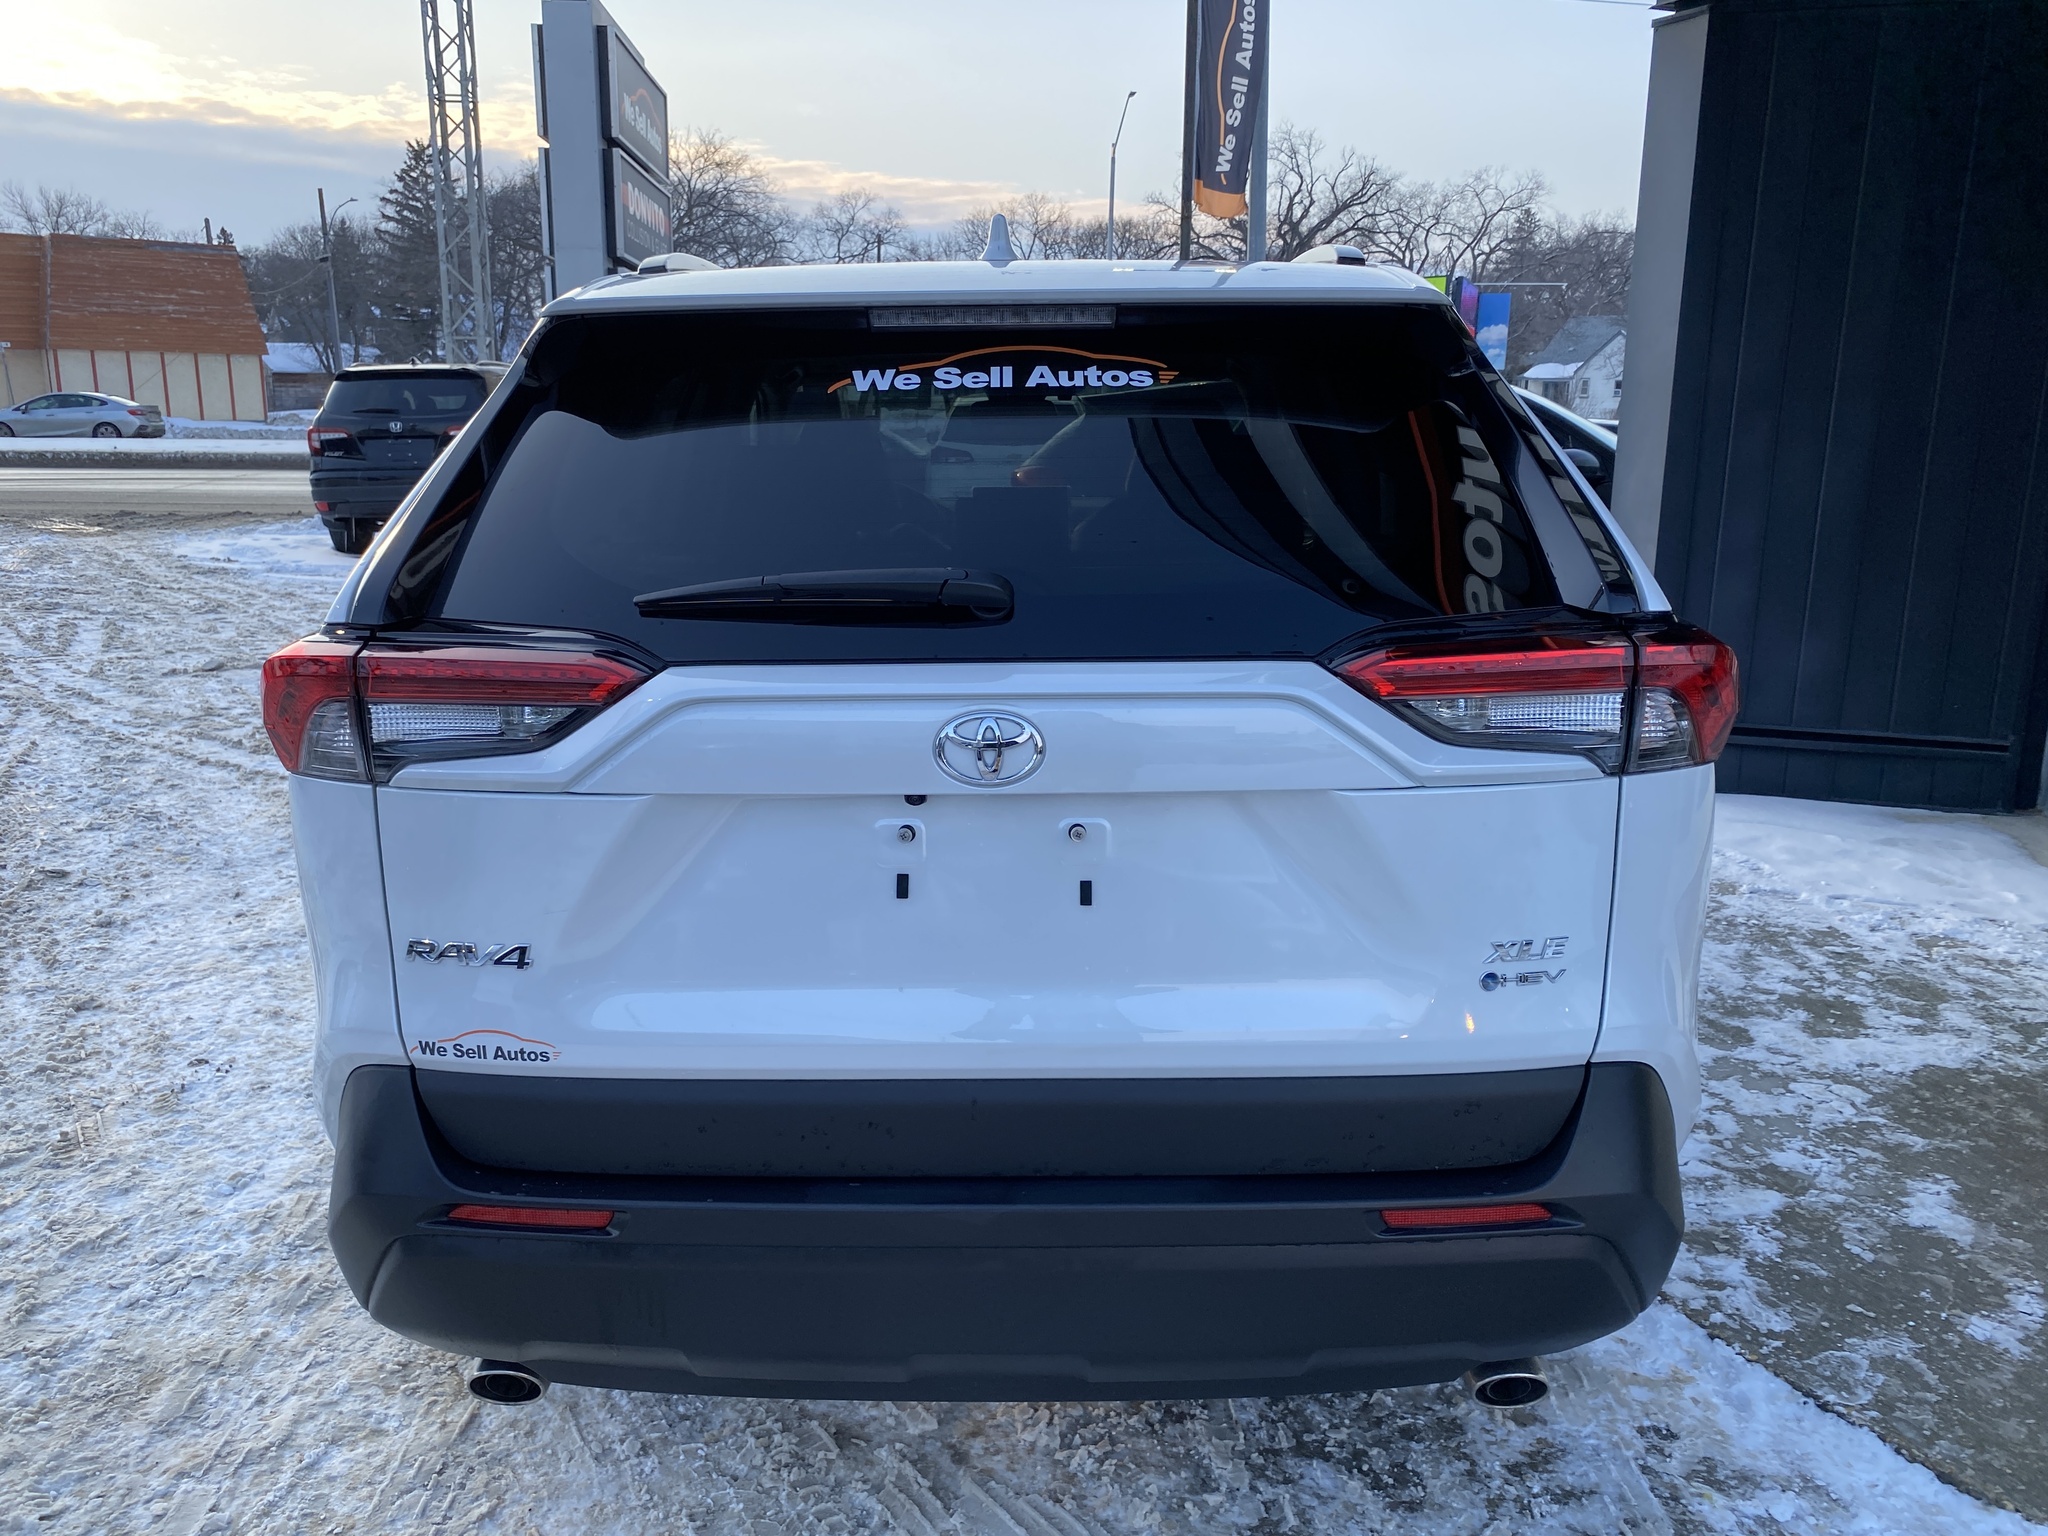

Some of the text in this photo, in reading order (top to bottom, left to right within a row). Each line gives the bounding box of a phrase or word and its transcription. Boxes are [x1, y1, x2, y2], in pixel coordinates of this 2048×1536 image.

[623, 92, 635, 126] We
[635, 105, 647, 139] Sell
[1215, 134, 1236, 172] We
[1226, 76, 1249, 127] Sell
[627, 181, 665, 237] DONVITO
[851, 365, 1154, 392] We Sell Autos
[405, 937, 534, 971] RAV4
[1482, 936, 1570, 964] XLE
[418, 1040, 551, 1062] We Sell Autos
